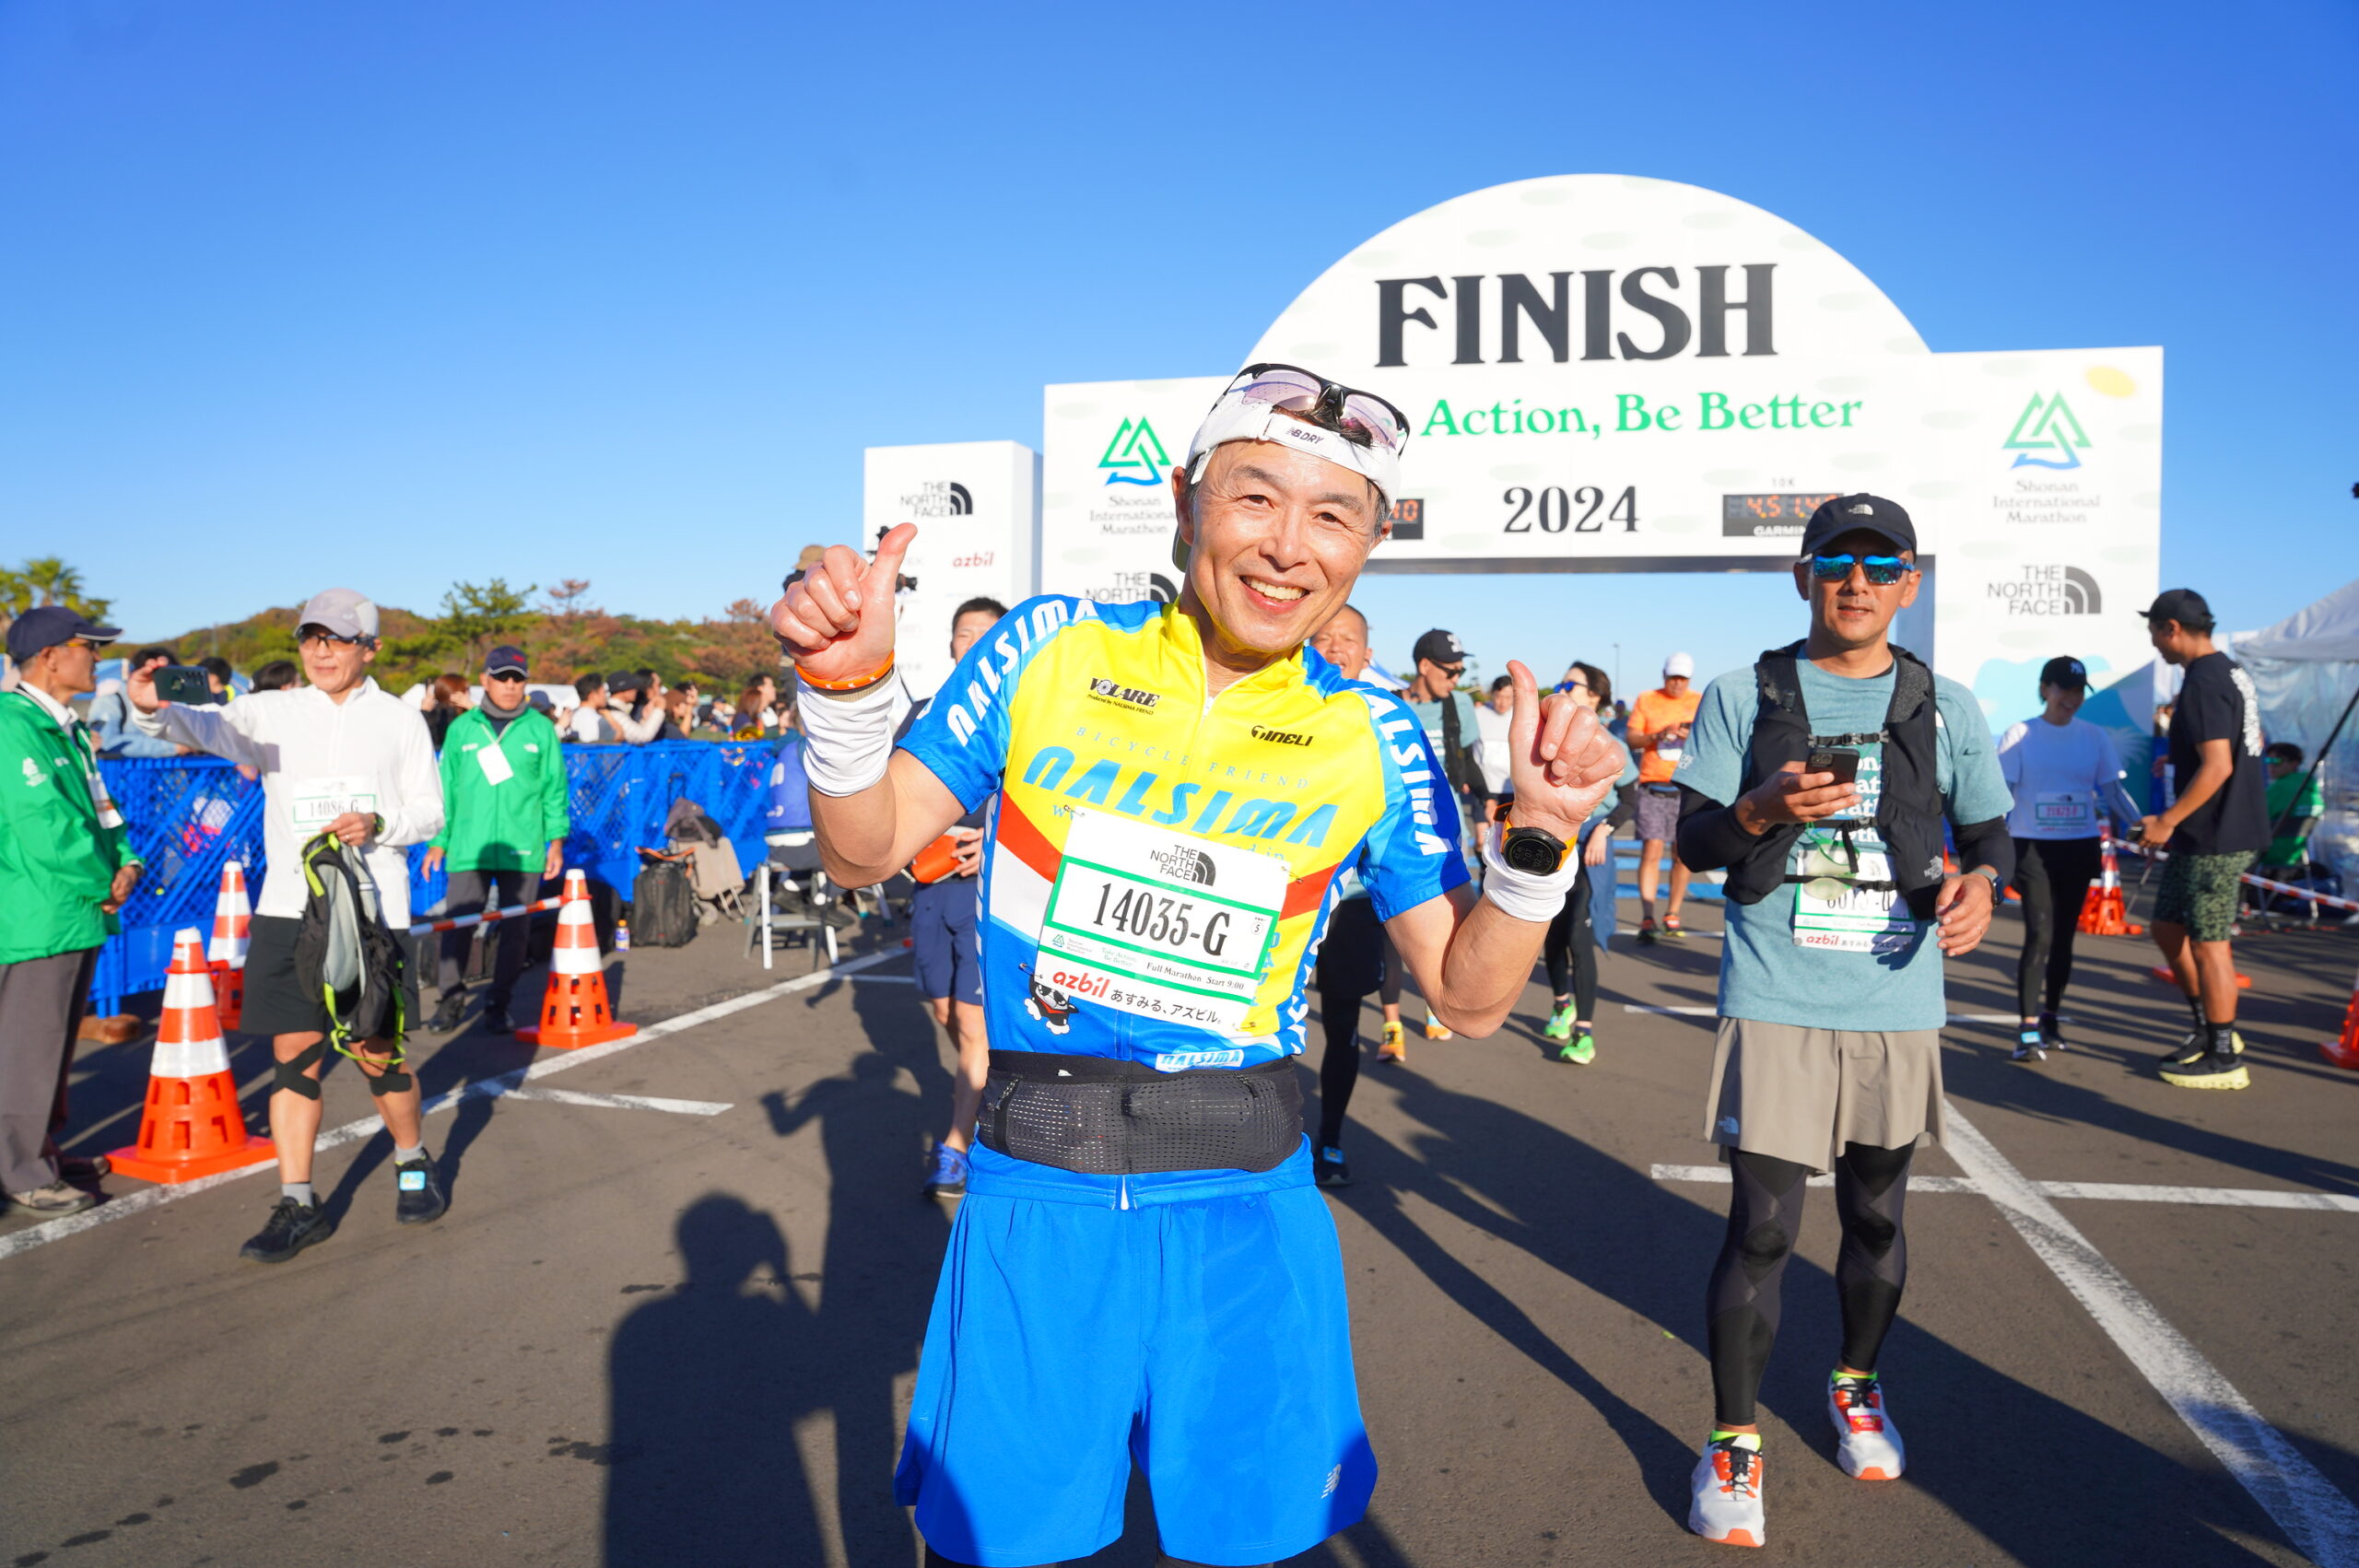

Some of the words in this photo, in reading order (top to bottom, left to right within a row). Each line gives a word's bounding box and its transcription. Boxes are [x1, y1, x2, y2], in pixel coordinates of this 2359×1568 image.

[1374, 263, 1778, 368] FINISH
[1420, 398, 1602, 439] Action,
[1614, 394, 1683, 432] Be
[1697, 392, 1863, 430] Better
[1300, 432, 1324, 444] DRY
[923, 481, 946, 493] THE
[2014, 479, 2080, 493] Shonan
[900, 495, 948, 507] NORTH
[1109, 496, 1161, 508] Shonan
[1993, 495, 2101, 509] International
[914, 506, 947, 517] FACE
[1090, 509, 1177, 522] Internationa
[1503, 486, 1640, 533] 2024
[2006, 510, 2088, 524] Marathon
[1100, 523, 1168, 534] Marathon
[953, 552, 994, 568] azbil
[1114, 572, 1146, 586] THE
[2022, 564, 2061, 581] THE
[1086, 588, 1147, 603] NORTH
[1988, 582, 2061, 598] NORTH
[2009, 599, 2061, 615] FACE
[1089, 677, 1160, 708] VOLARE
[1075, 726, 1190, 766] BICYCLE
[1208, 762, 1309, 790] FRIEND
[1363, 693, 1454, 856] ALSIMA
[1150, 849, 1195, 871] NORTH
[1174, 844, 1198, 860] THE
[1160, 863, 1192, 881] FACE
[1094, 883, 1230, 956] 14035-G
[1806, 934, 1840, 946] azbil
[1146, 962, 1163, 973] Full
[1164, 966, 1203, 983] Marathon
[1206, 977, 1226, 987] Start
[1226, 980, 1245, 990] 9:00
[1052, 971, 1110, 998] azbil
